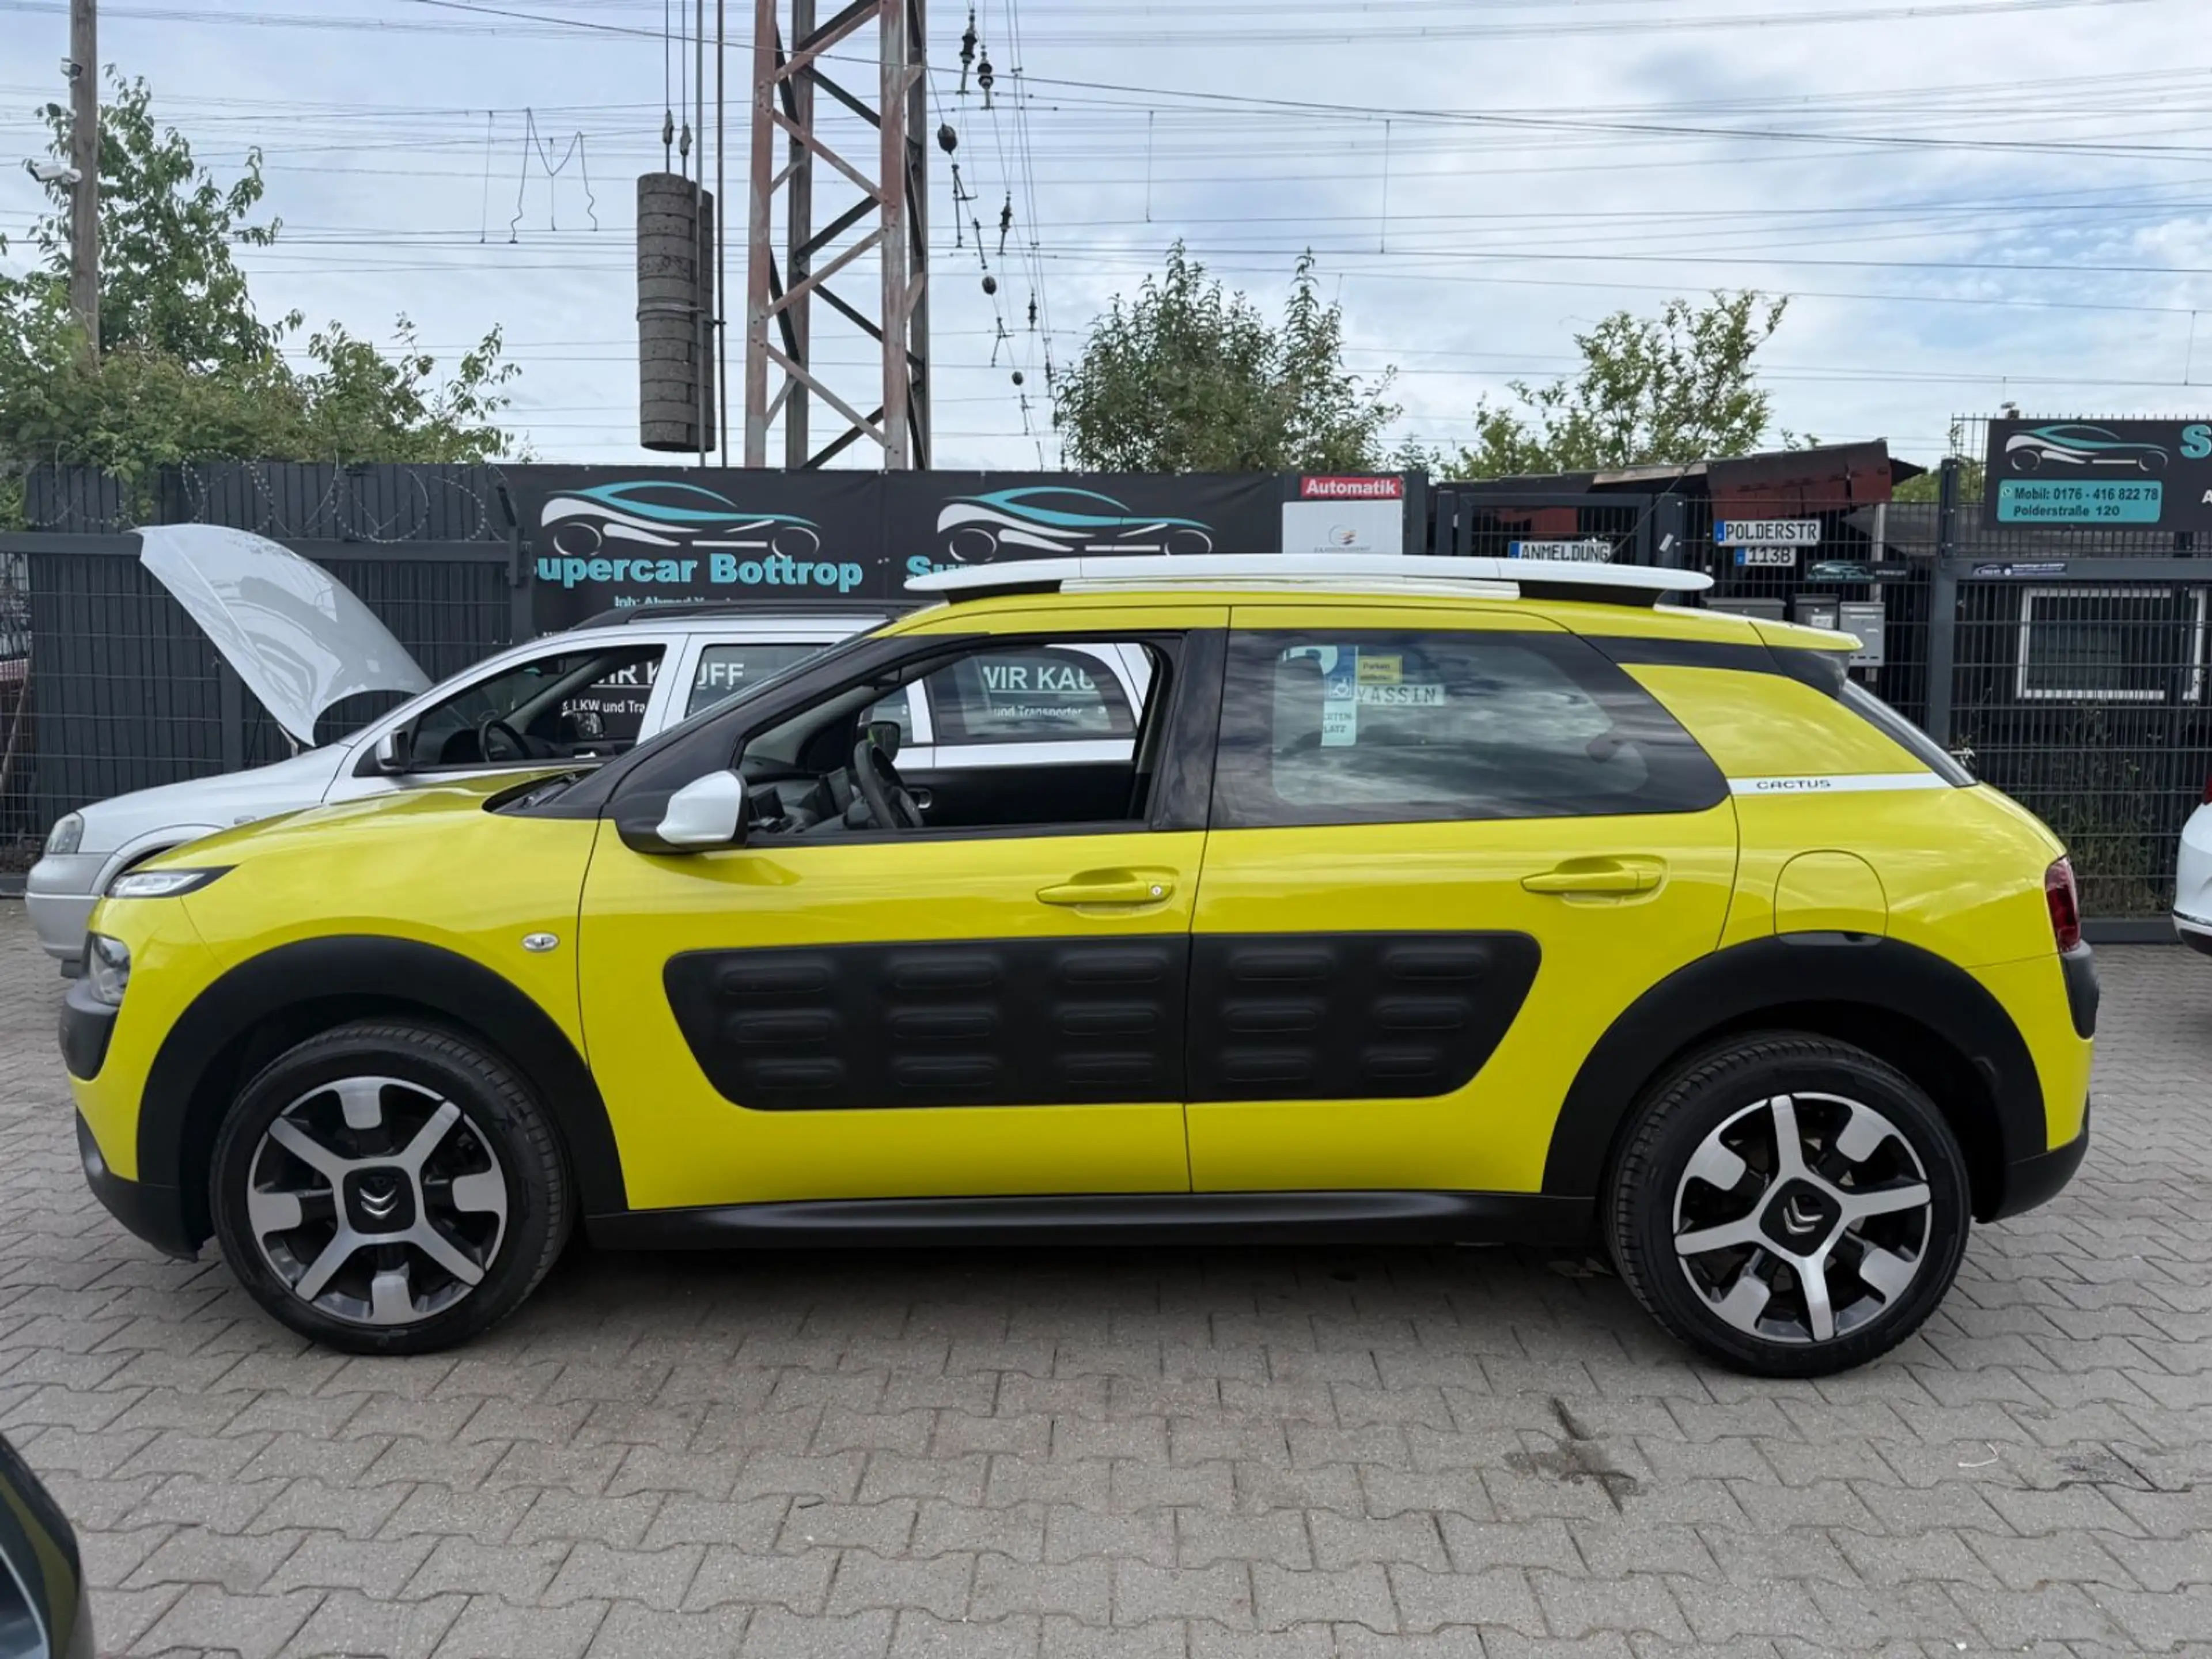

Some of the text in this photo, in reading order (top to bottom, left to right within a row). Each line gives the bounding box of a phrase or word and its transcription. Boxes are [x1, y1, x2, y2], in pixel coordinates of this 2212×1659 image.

[1306, 479, 1396, 495] Automatik
[2014, 487, 2050, 500] Mobil:
[2053, 487, 2082, 500] 0176
[2092, 488, 2115, 500] 416
[2118, 488, 2141, 501] 822
[2144, 488, 2159, 501] 78
[2013, 505, 2120, 517] Polderstraße 120
[1726, 523, 1817, 540] POLDERSTR
[1521, 544, 1609, 563] ANMELDUNG
[533, 556, 698, 589] upercar
[710, 553, 863, 593] Bottrop
[1037, 666, 1095, 690] KAU
[1358, 686, 1436, 704] YASSIN
[572, 699, 600, 711] LKW
[603, 700, 625, 713] und
[1756, 779, 1831, 789] CACTUS
